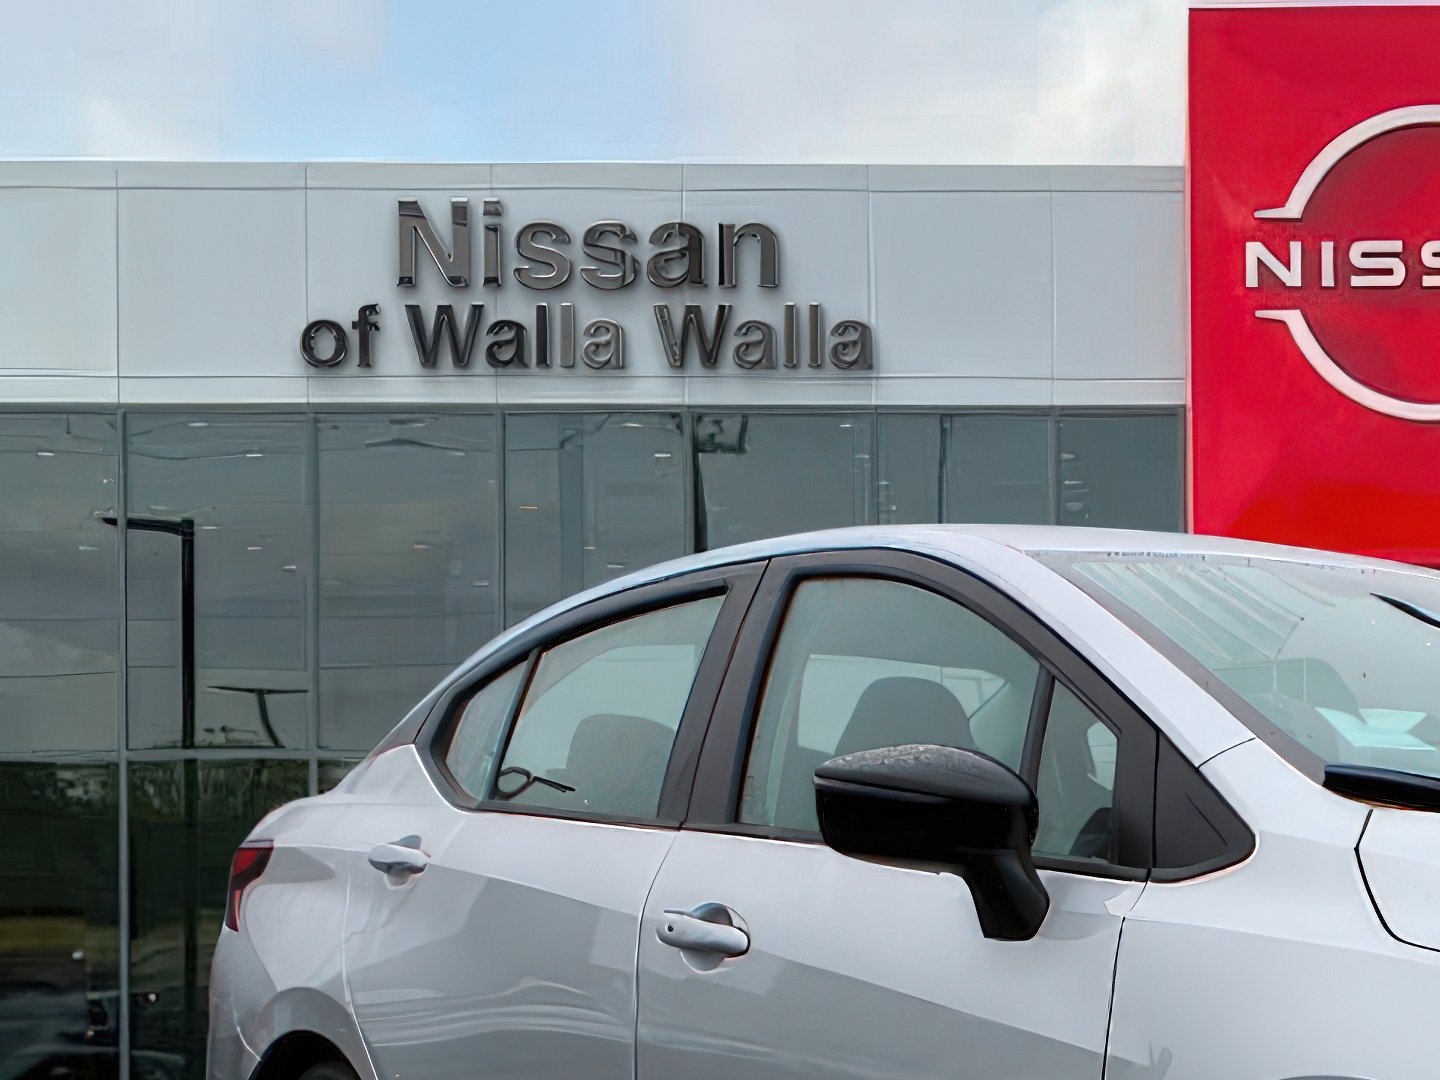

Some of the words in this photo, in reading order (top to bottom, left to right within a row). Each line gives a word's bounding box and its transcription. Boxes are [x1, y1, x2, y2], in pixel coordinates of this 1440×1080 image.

[397, 198, 781, 290] Nissan
[300, 303, 381, 369] of
[405, 303, 626, 370] Walla
[653, 303, 875, 370] Walla
